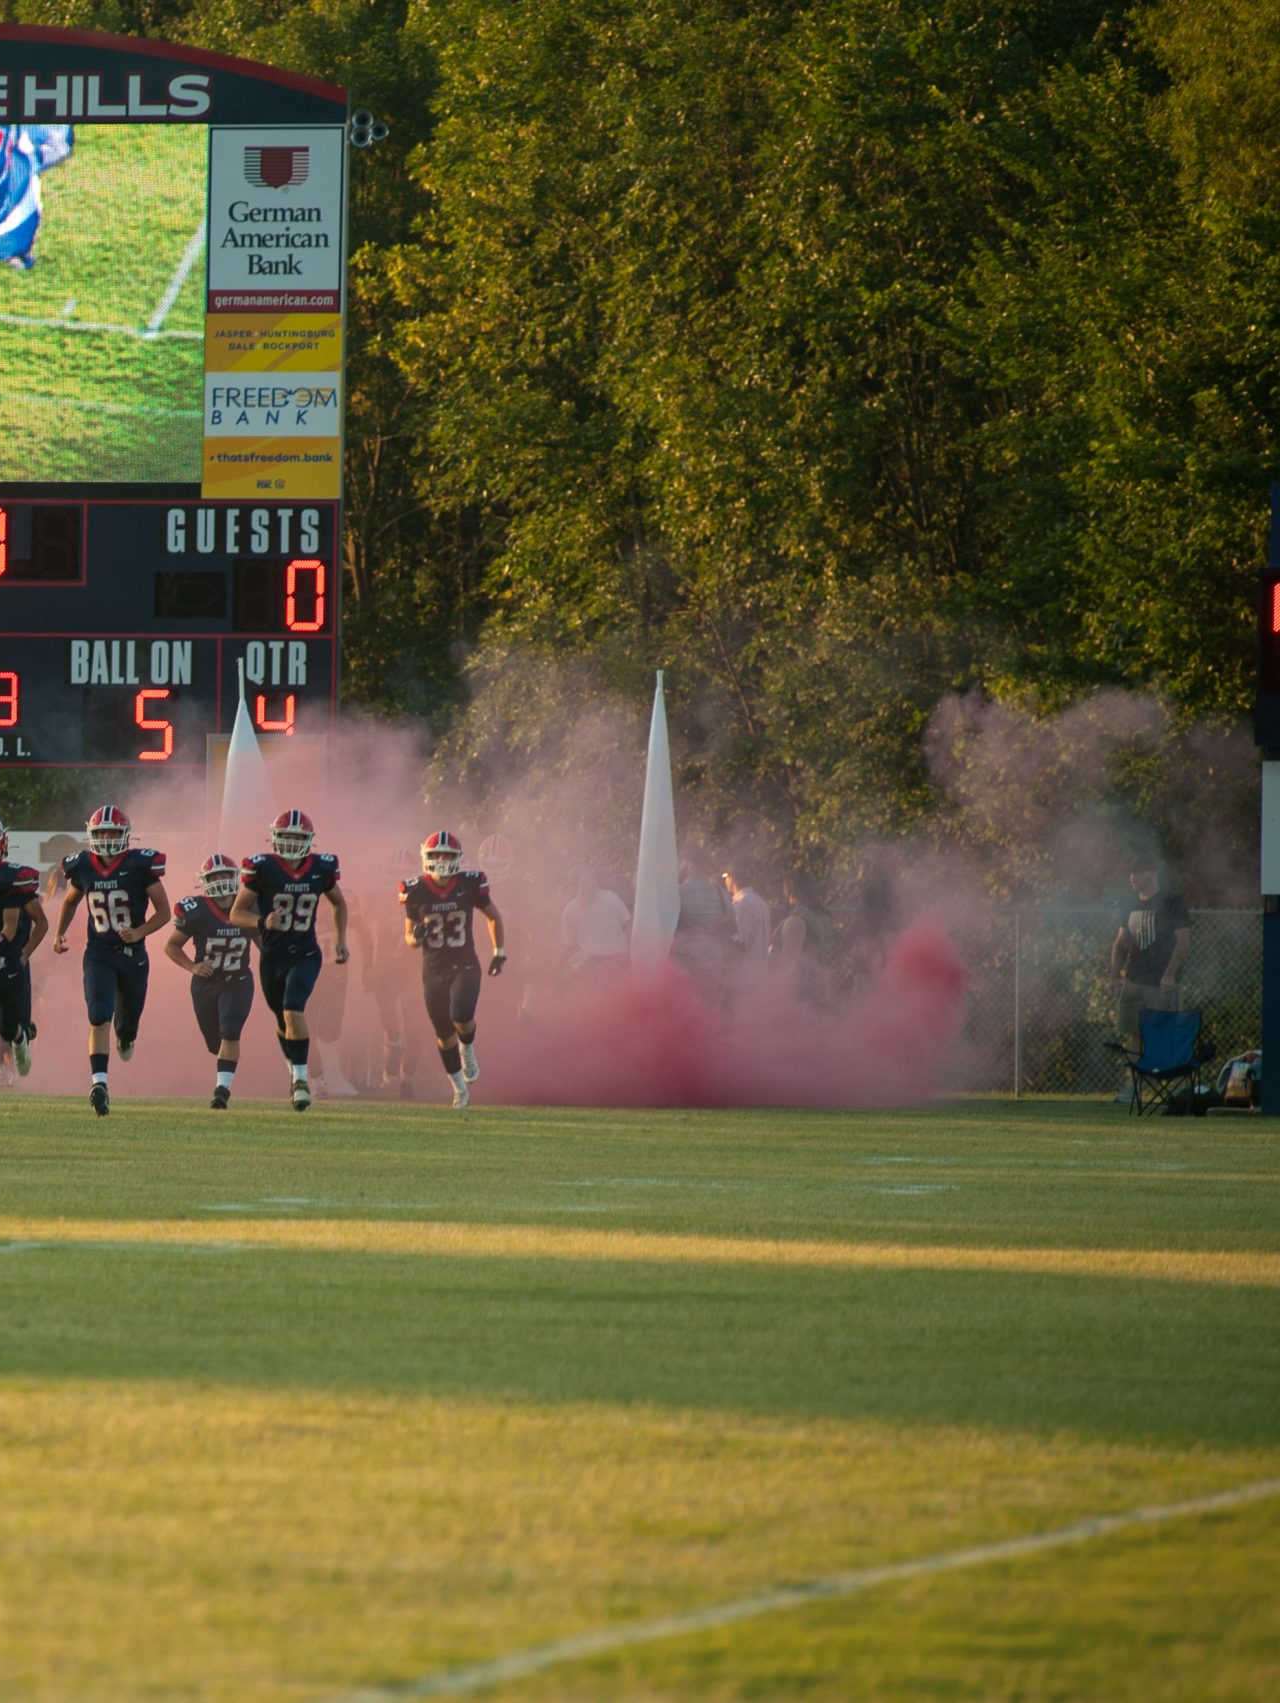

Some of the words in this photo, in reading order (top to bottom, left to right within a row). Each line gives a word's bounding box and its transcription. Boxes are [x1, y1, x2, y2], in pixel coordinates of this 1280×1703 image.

[23, 75, 210, 117] HILLS
[227, 200, 322, 223] German
[220, 228, 330, 249] American
[247, 253, 303, 276] Bank
[214, 294, 334, 308] germanamerican.com
[214, 329, 253, 338] JASPER
[259, 329, 336, 338] HUNTINGBURG
[228, 341, 255, 351] DALE
[262, 341, 320, 351] ROCKPORT
[212, 386, 338, 409] FREEDOM
[217, 452, 333, 464] thatsfreedom.bank
[166, 508, 320, 554] GUESTS
[286, 559, 326, 632] 0
[70, 639, 140, 685] BALL
[150, 640, 192, 685] ON
[246, 640, 307, 686] QTR
[135, 689, 174, 761] 5
[94, 880, 119, 889] PATRIOTS
[284, 883, 310, 892] PATRIOTS
[87, 890, 132, 933] 66
[272, 893, 318, 932] 89
[216, 928, 241, 937] PATRIOTS
[425, 910, 467, 949] 33
[205, 936, 247, 971] 52
